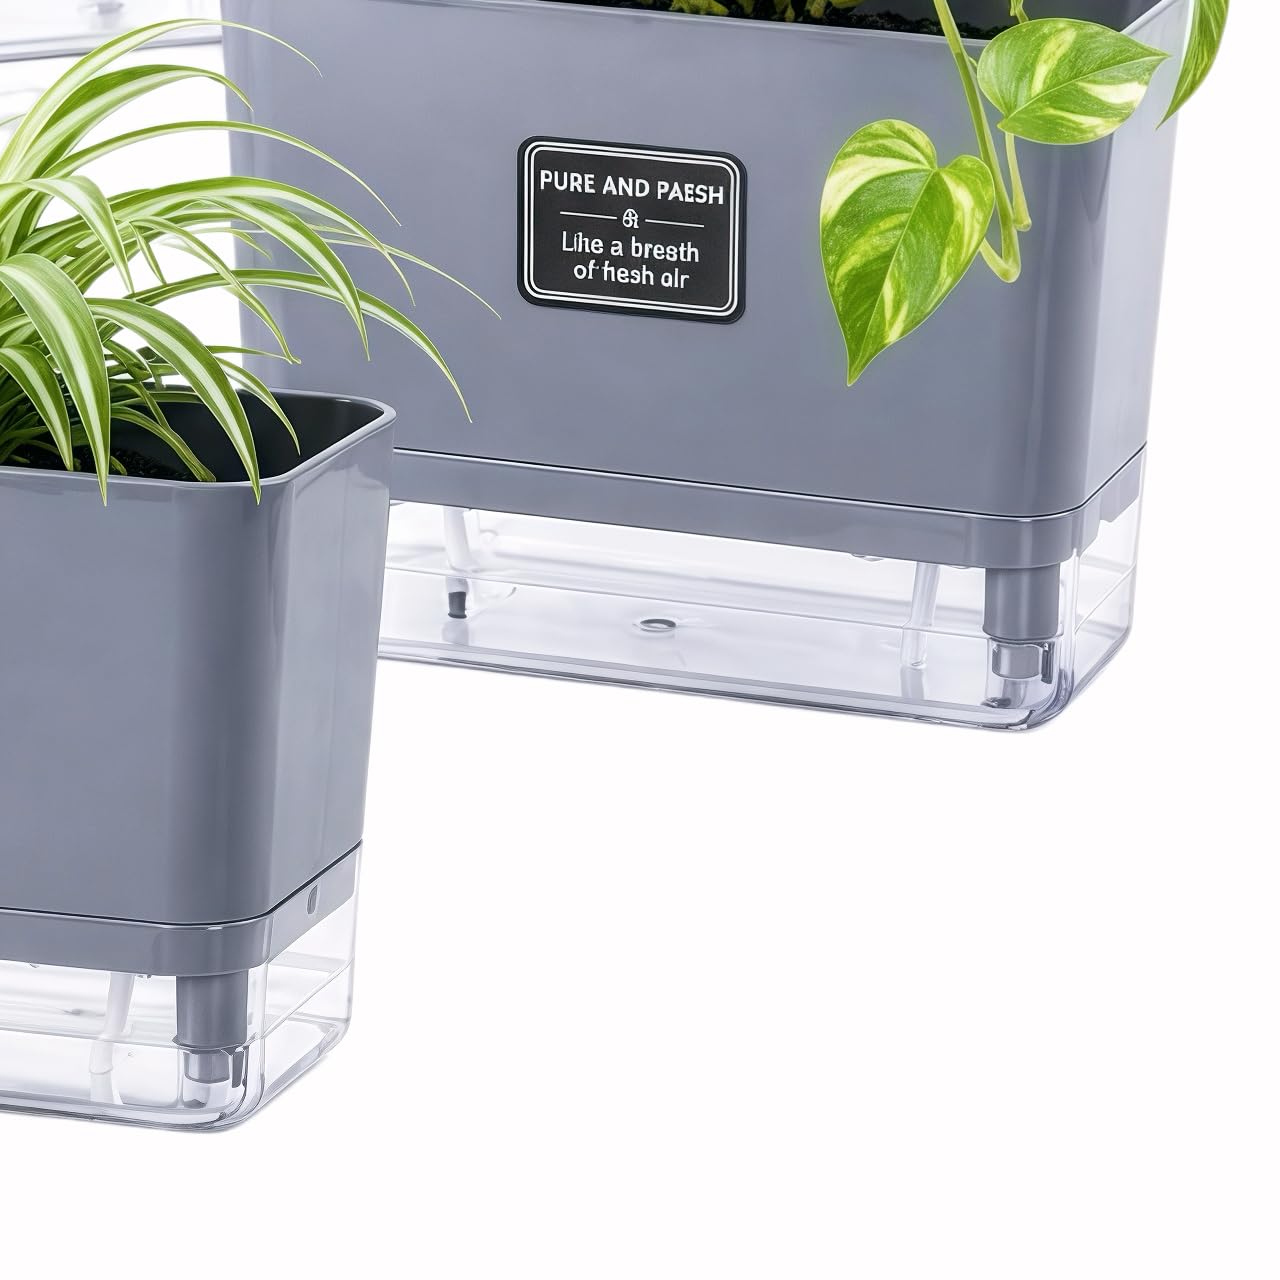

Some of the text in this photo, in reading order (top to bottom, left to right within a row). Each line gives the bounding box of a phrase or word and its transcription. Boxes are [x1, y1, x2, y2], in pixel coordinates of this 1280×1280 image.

[540, 169, 596, 194] PURE
[602, 175, 650, 198] AND
[610, 240, 624, 257] a
[573, 259, 600, 280] of
